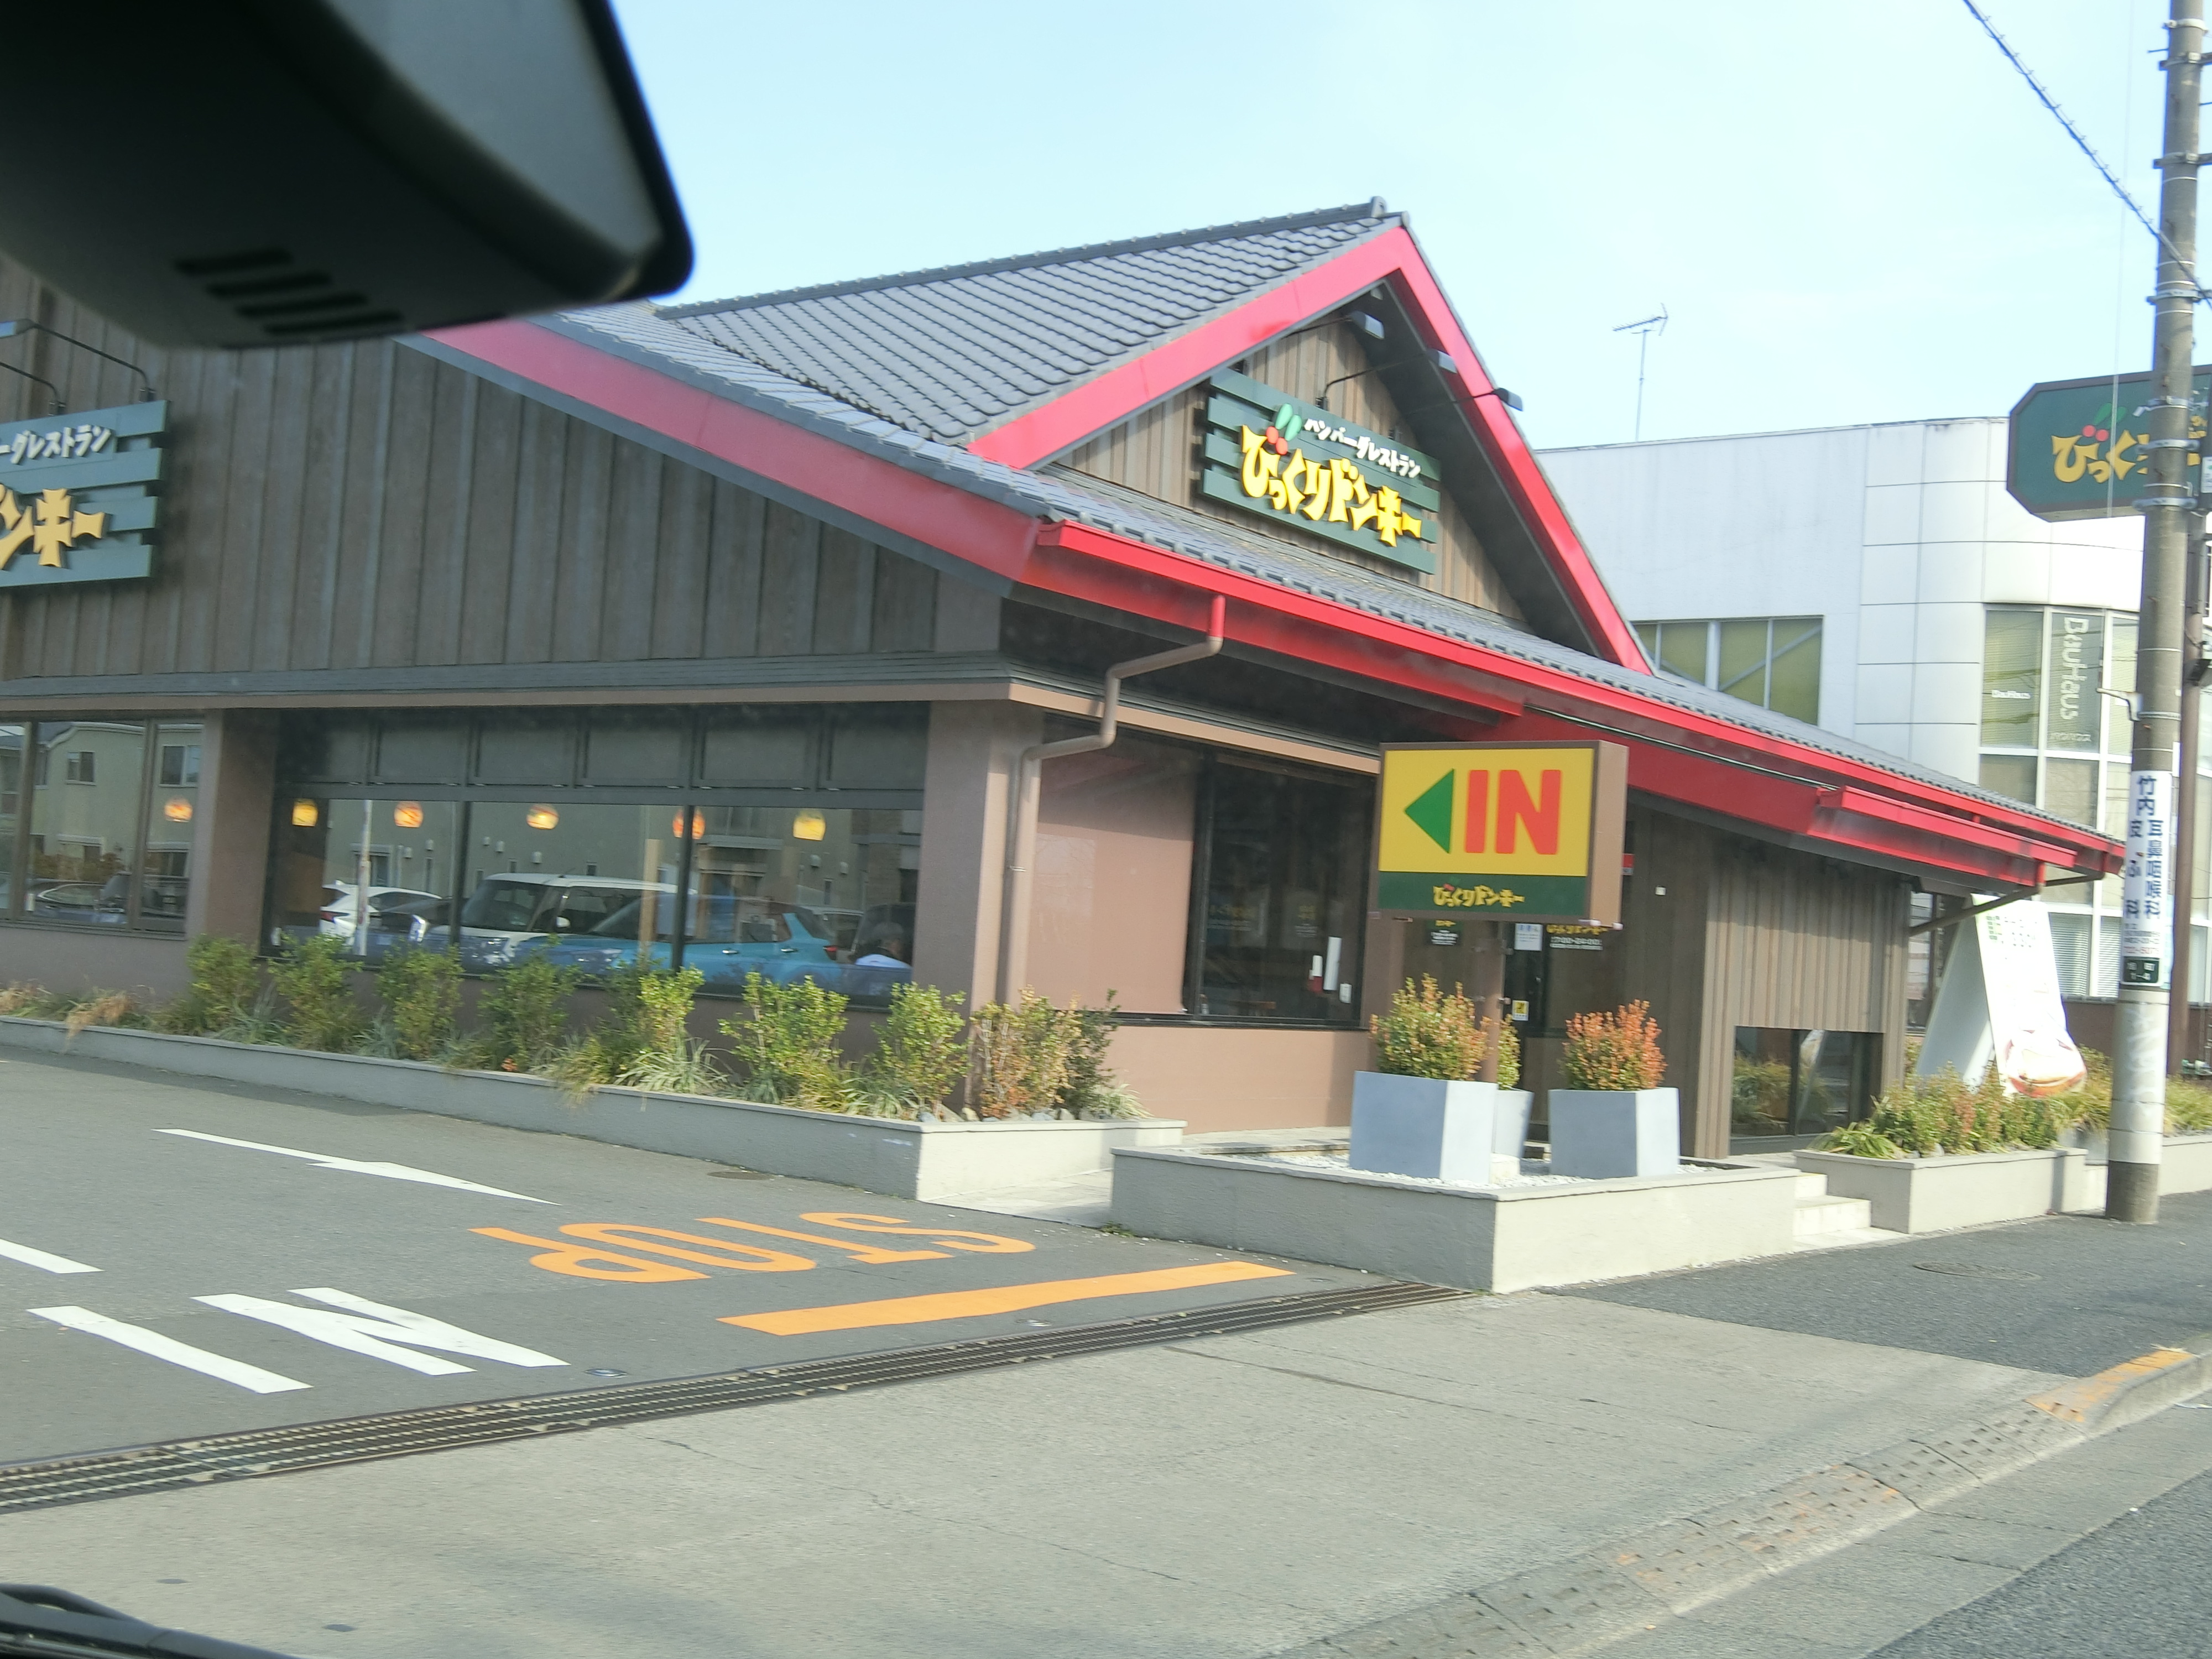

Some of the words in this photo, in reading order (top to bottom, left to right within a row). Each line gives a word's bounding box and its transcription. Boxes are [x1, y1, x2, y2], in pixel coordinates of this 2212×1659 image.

[1241, 425, 1422, 547] びっくりドンキー
[1304, 418, 1421, 478] ハンバーグレストラン
[2051, 430, 2150, 483] びっく
[0, 483, 105, 570] ンキー
[1464, 769, 1562, 855] IN
[1433, 885, 1525, 907] びっくりドンキー
[468, 1211, 1035, 1283] STOP
[26, 1286, 571, 1394] IN
